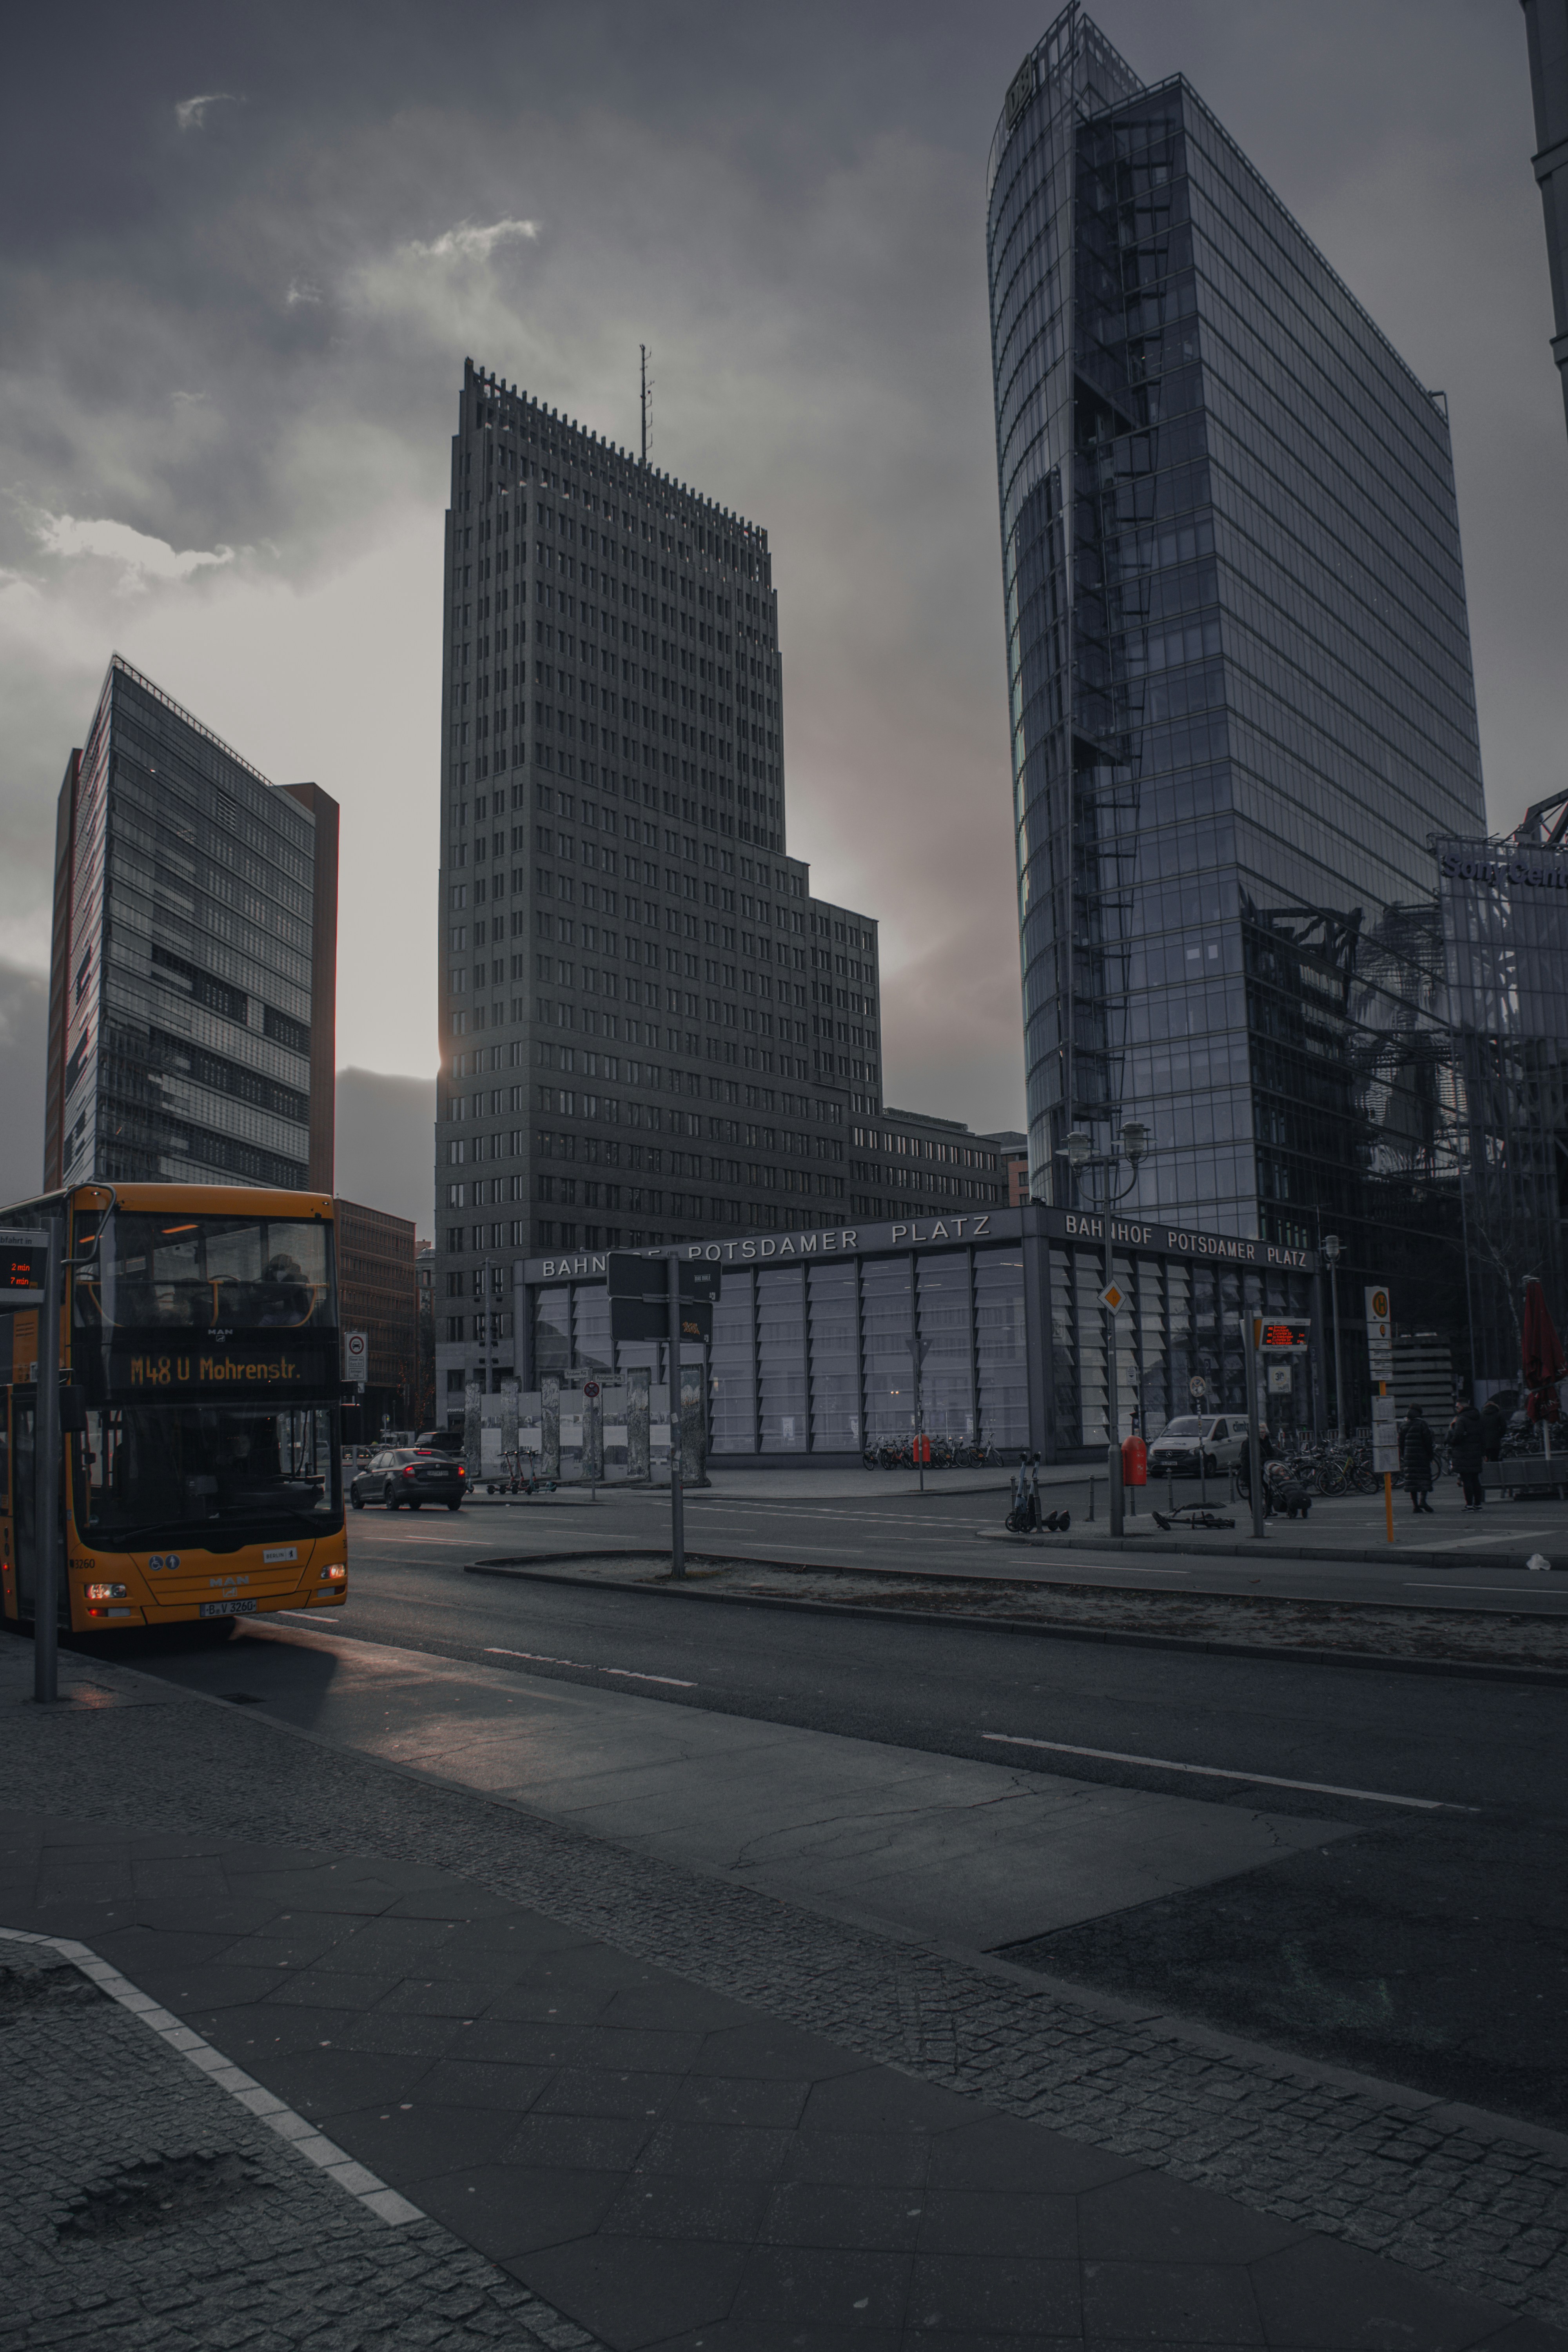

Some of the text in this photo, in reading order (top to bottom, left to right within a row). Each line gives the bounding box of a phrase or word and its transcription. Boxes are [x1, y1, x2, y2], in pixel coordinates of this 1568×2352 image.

[999, 65, 1029, 123] DB
[1444, 853, 1508, 887] Sony
[688, 1230, 858, 1260] POTSDAMER
[892, 1216, 989, 1243] PLATZ
[1167, 1232, 1254, 1259] POTSDAMER
[1267, 1247, 1307, 1267] PLATZ
[1378, 1297, 1386, 1312] H
[131, 1355, 300, 1385] M48 U Mohrenstr.
[75, 1558, 95, 1569] 3260
[209, 1575, 249, 1588] MAN
[209, 1601, 253, 1615] B V 3260
